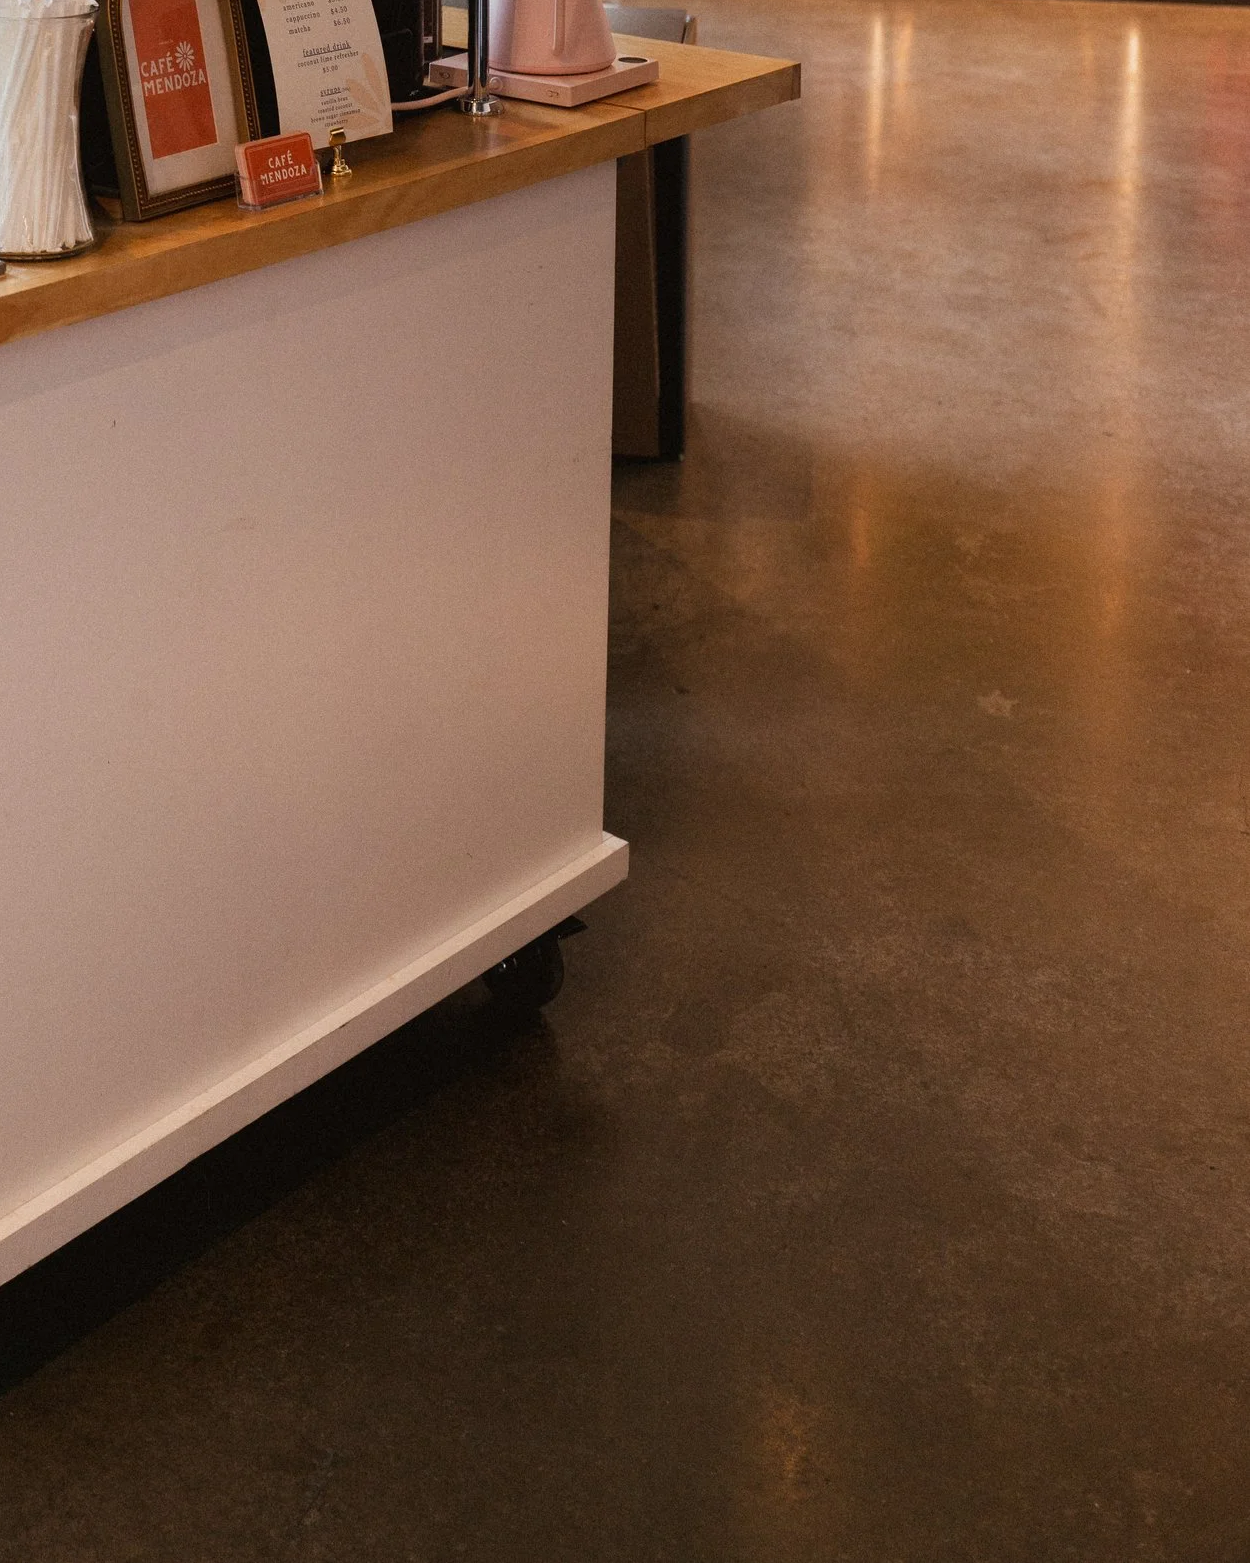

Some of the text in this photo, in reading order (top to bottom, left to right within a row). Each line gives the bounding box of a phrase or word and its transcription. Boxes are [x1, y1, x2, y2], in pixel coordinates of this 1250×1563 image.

[283, 0, 315, 11] americano
[286, 5, 348, 23] cappuccino $4.50
[288, 17, 351, 35] matcha $6.50
[302, 41, 352, 57] featured drink
[141, 51, 174, 77] CAFÉ
[297, 58, 320, 68] coconut
[320, 55, 333, 64] lime
[143, 68, 207, 97] MENDOZA
[268, 149, 294, 169] CAFÉ
[260, 163, 307, 186] MENDOZA
